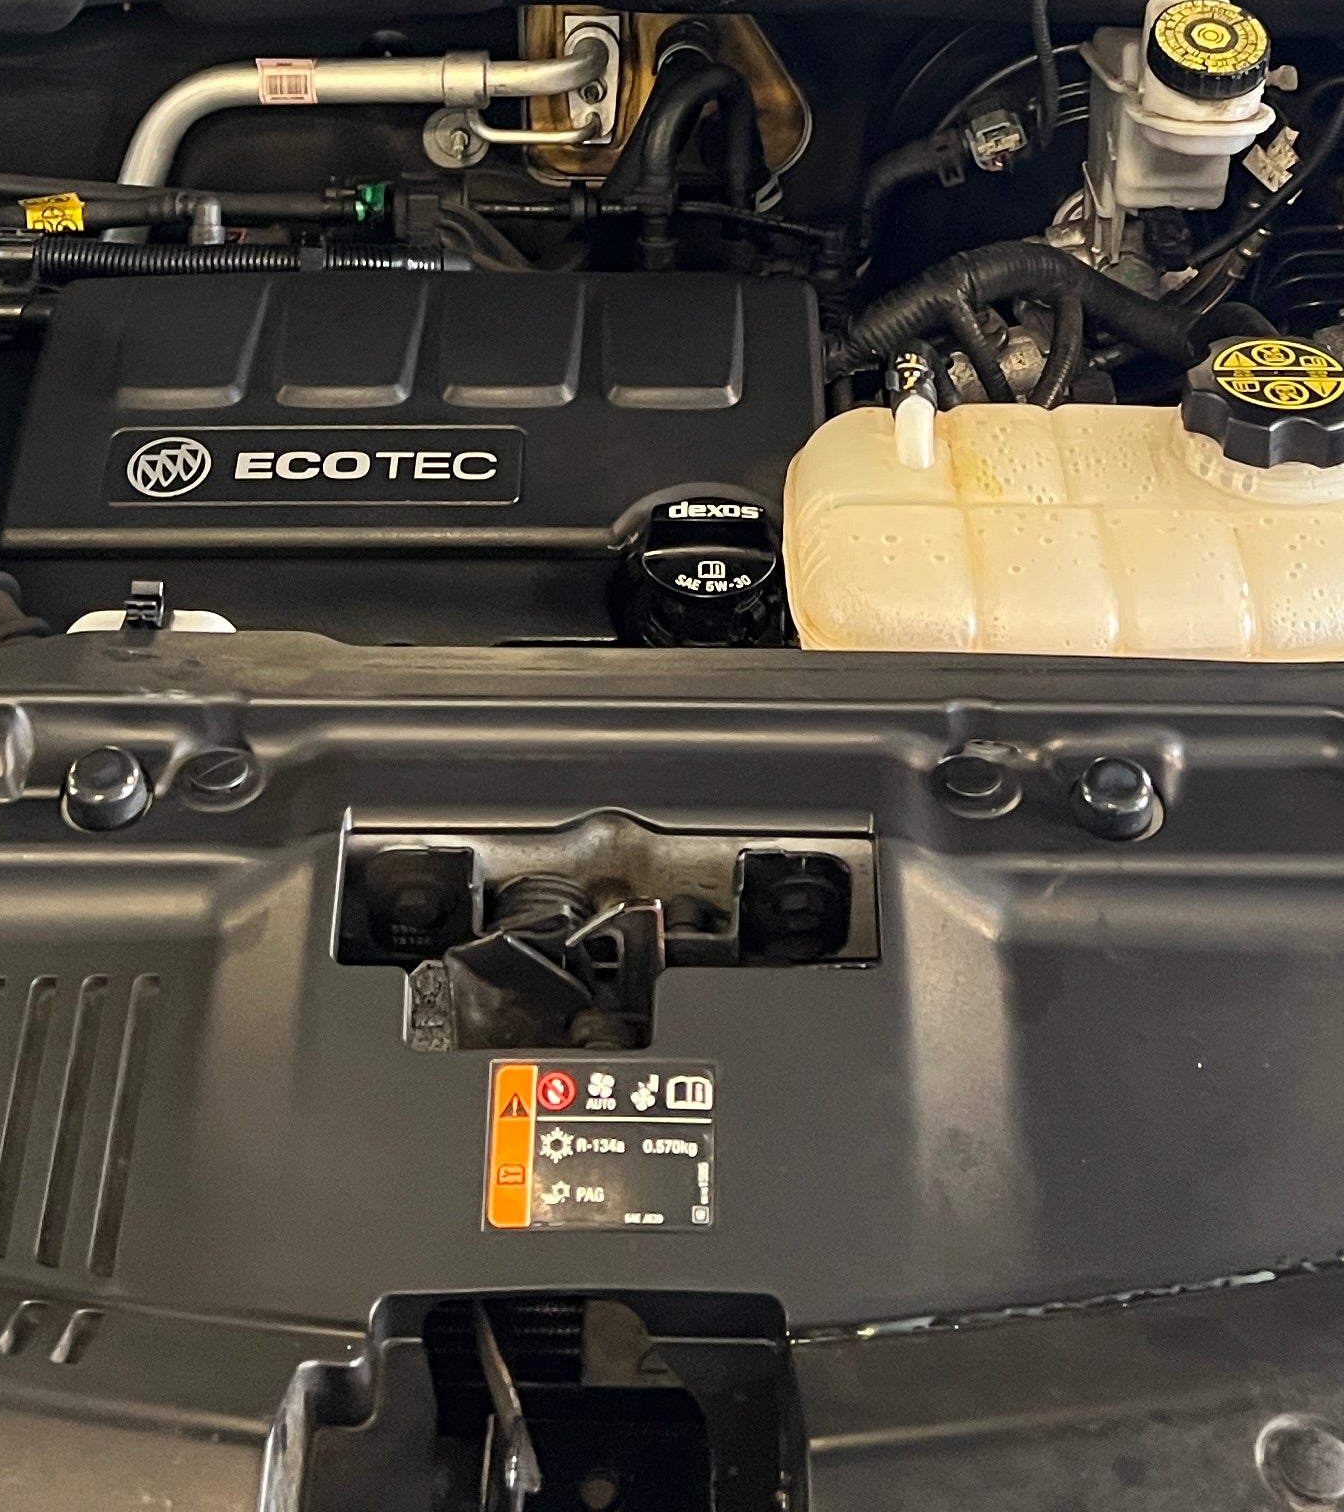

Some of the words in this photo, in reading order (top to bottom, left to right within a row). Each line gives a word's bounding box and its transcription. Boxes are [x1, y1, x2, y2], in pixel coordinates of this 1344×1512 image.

[234, 451, 497, 480] ECOTEC
[668, 501, 759, 519] dexos
[674, 574, 701, 591] SAE
[586, 1098, 616, 1111] AUTO
[576, 1138, 625, 1154] R-134a
[642, 1139, 698, 1157] 0.570kg
[576, 1187, 605, 1203] PAG
